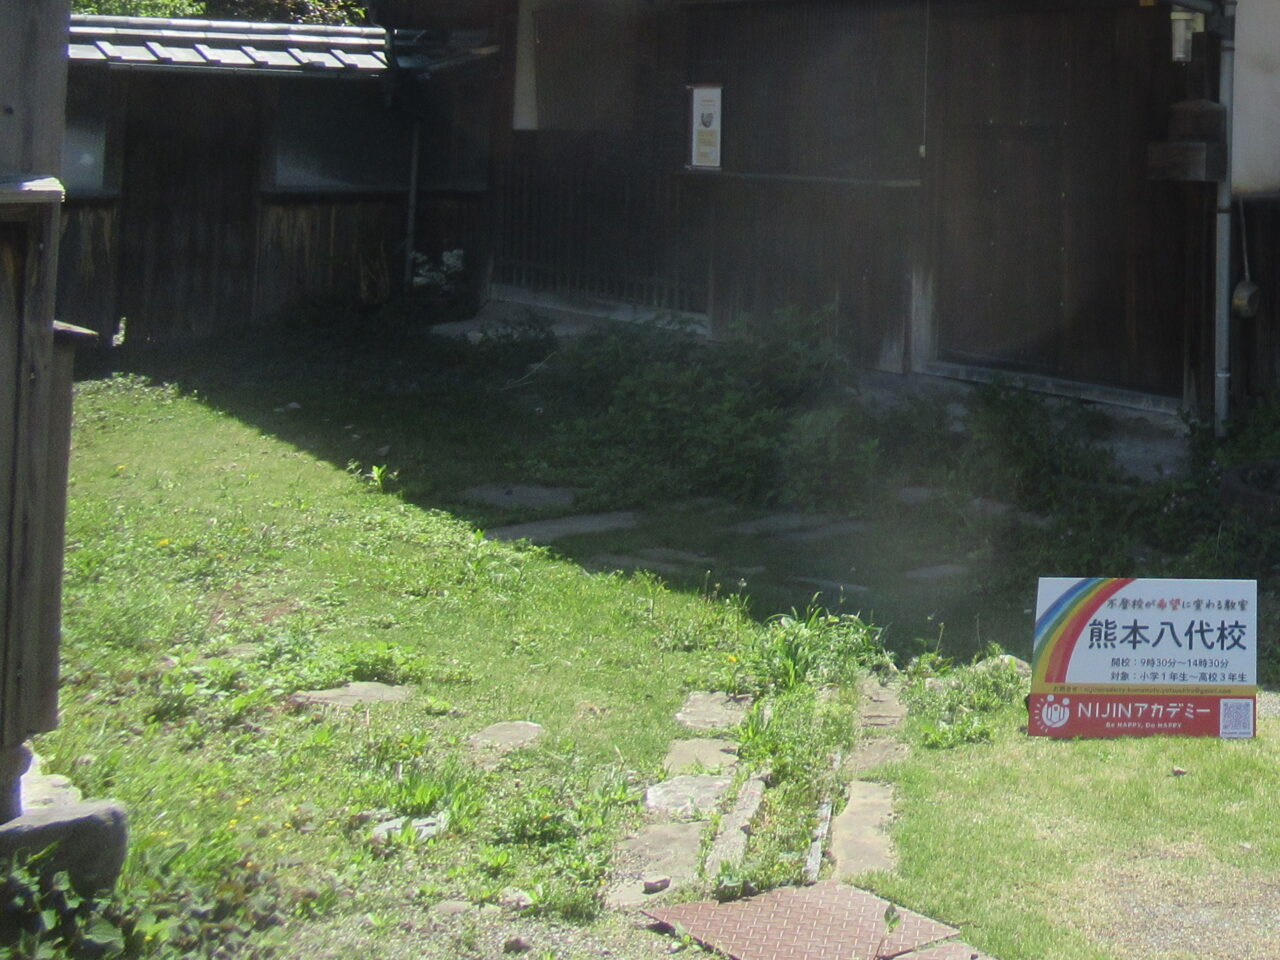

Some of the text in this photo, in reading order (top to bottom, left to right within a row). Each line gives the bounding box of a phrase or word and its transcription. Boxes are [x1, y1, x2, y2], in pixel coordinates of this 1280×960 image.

[1088, 618, 1248, 651] 熊本八代校
[1078, 702, 1211, 719] NIJINアカデミー
